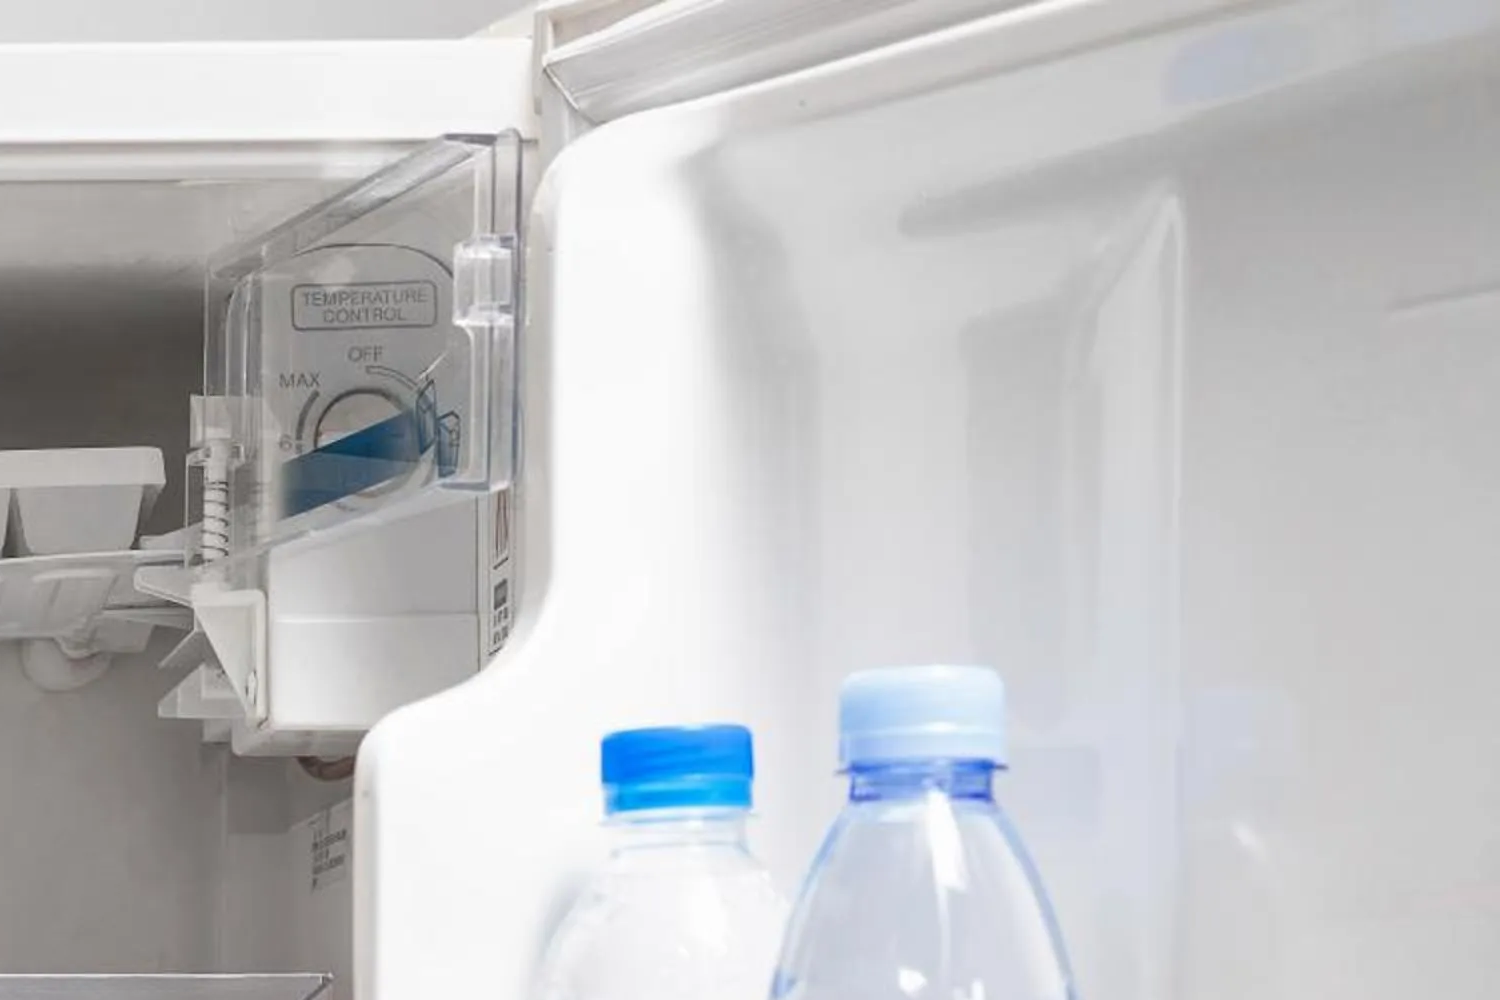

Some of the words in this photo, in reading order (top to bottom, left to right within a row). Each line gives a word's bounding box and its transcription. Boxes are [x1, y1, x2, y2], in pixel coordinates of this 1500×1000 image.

[303, 288, 428, 307] TEMPERATURE
[323, 307, 407, 324] CONTROL
[348, 346, 383, 362] OFF
[279, 372, 321, 389] MAX
